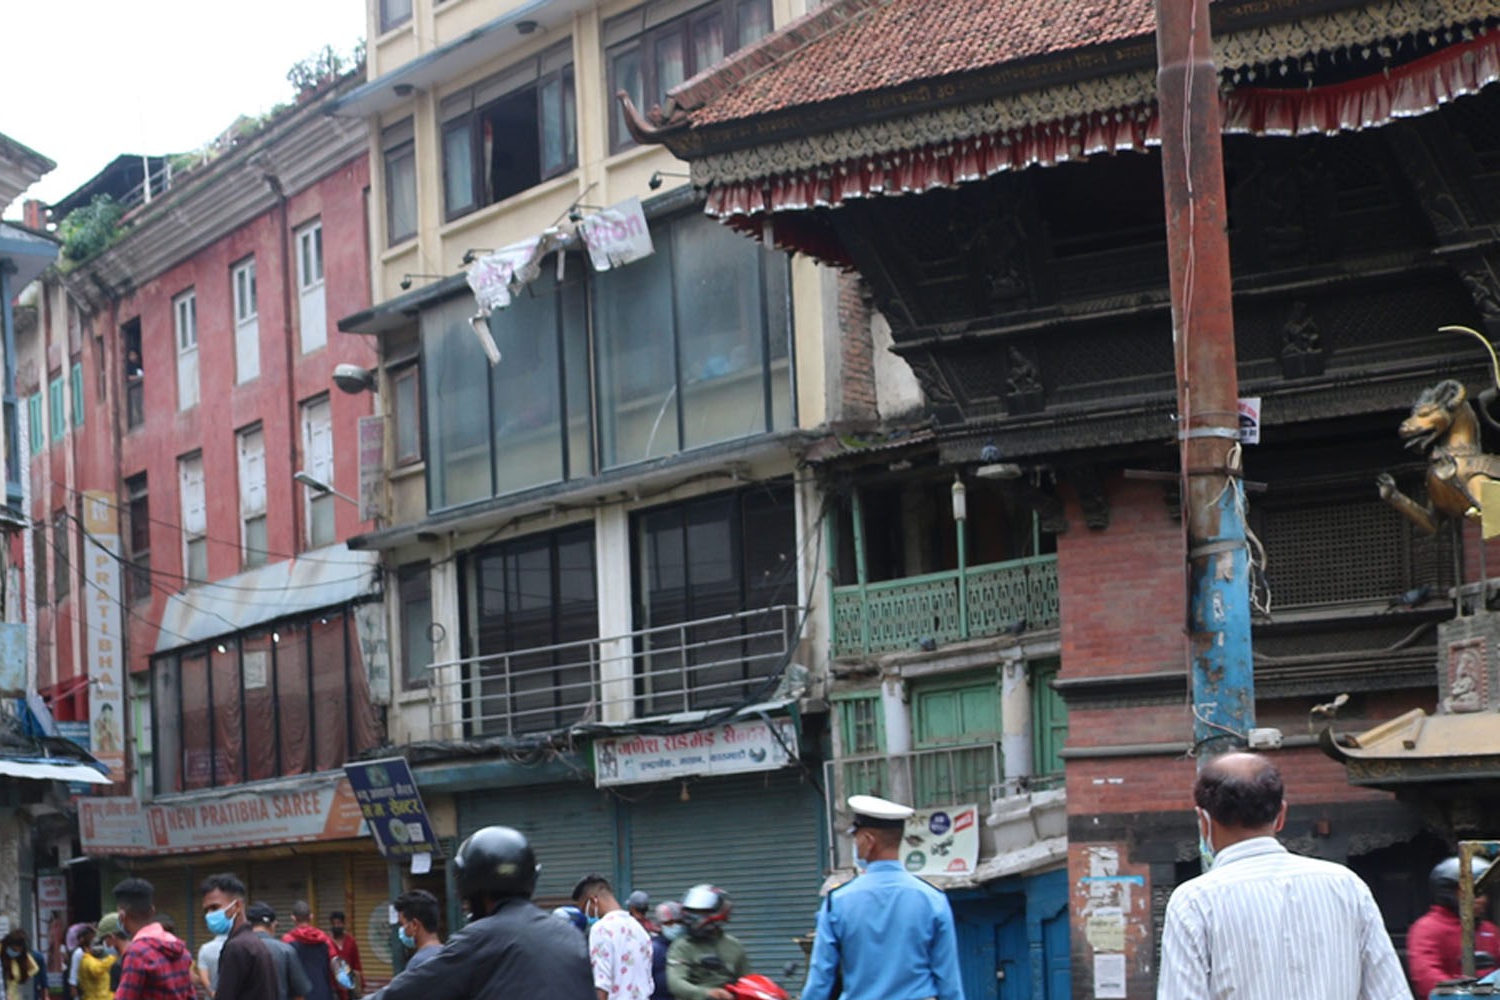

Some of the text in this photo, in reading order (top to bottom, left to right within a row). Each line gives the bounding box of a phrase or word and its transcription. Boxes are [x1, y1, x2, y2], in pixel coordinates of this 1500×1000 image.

[167, 807, 197, 831] NEW
[199, 796, 270, 827] PRATIBHA
[272, 790, 322, 818] SAREE
